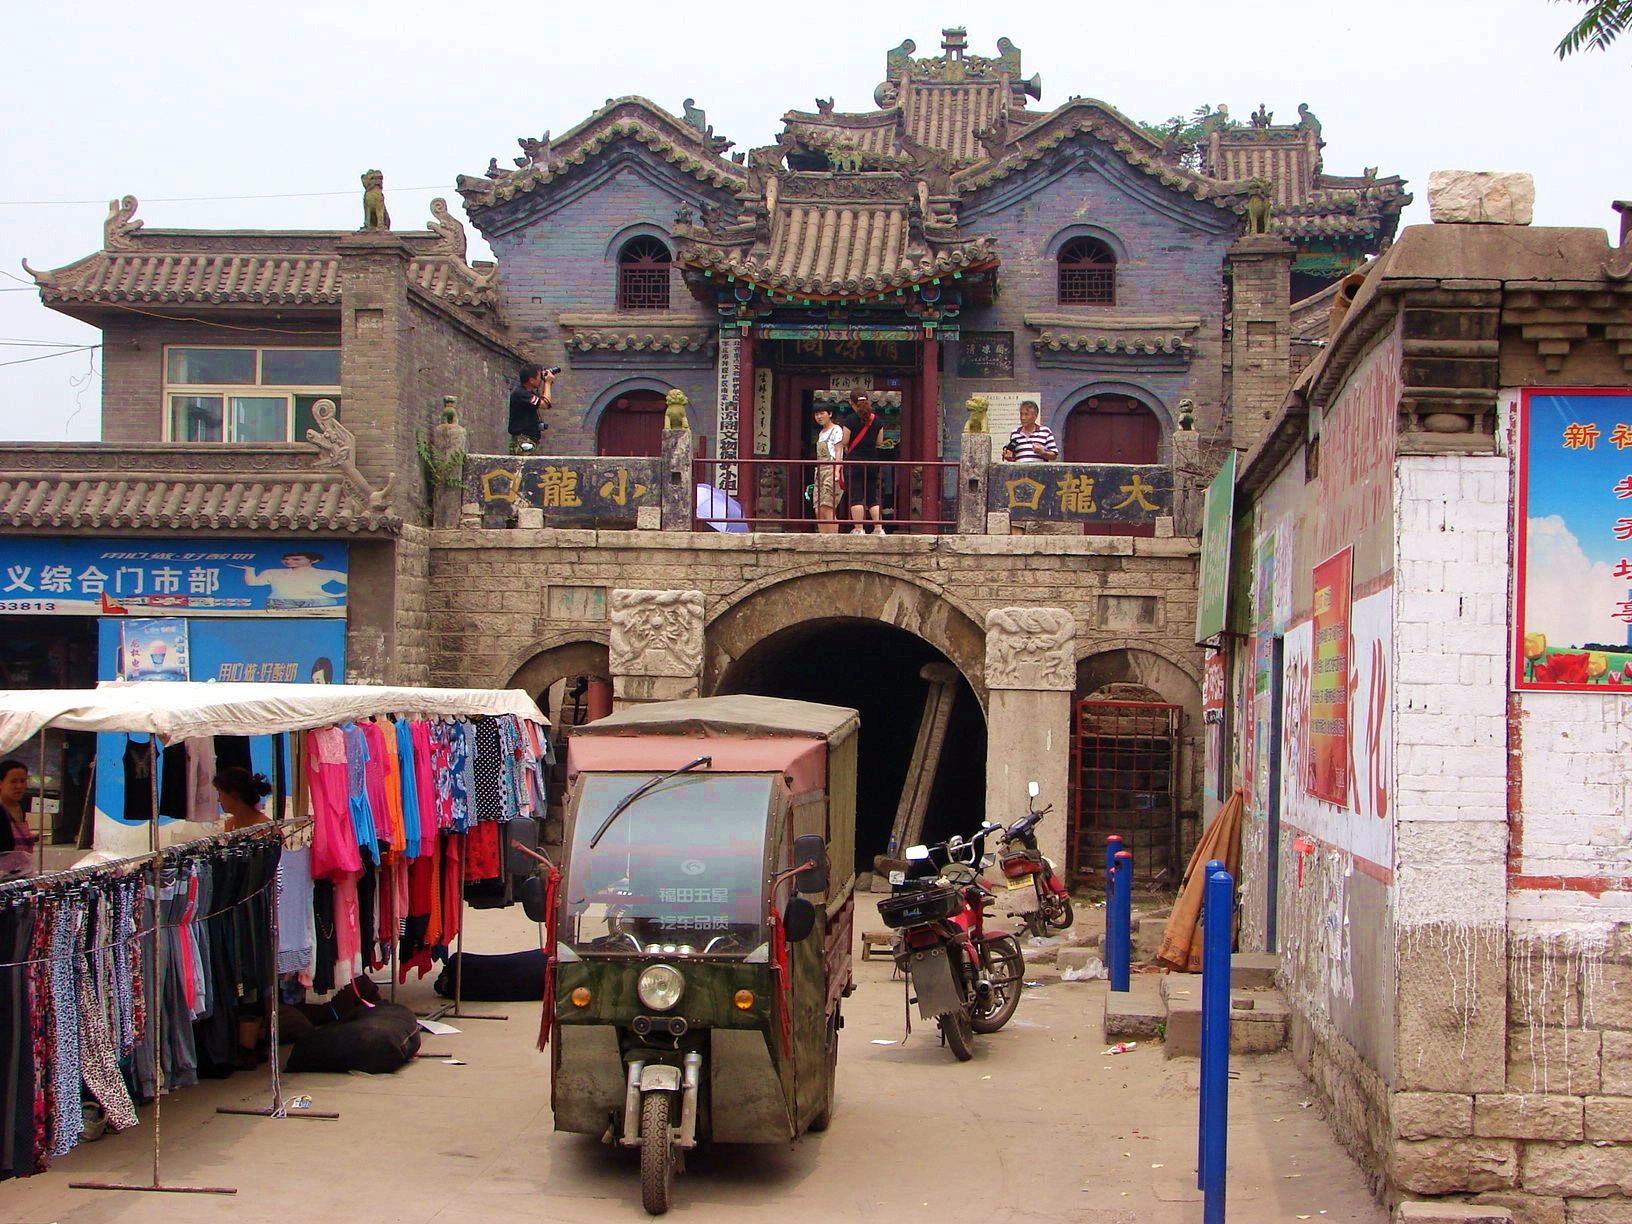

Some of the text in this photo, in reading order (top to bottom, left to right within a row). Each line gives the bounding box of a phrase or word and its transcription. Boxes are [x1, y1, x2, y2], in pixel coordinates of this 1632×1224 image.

[659, 888, 729, 903] 福田五星
[659, 915, 729, 930] 汽车品质
